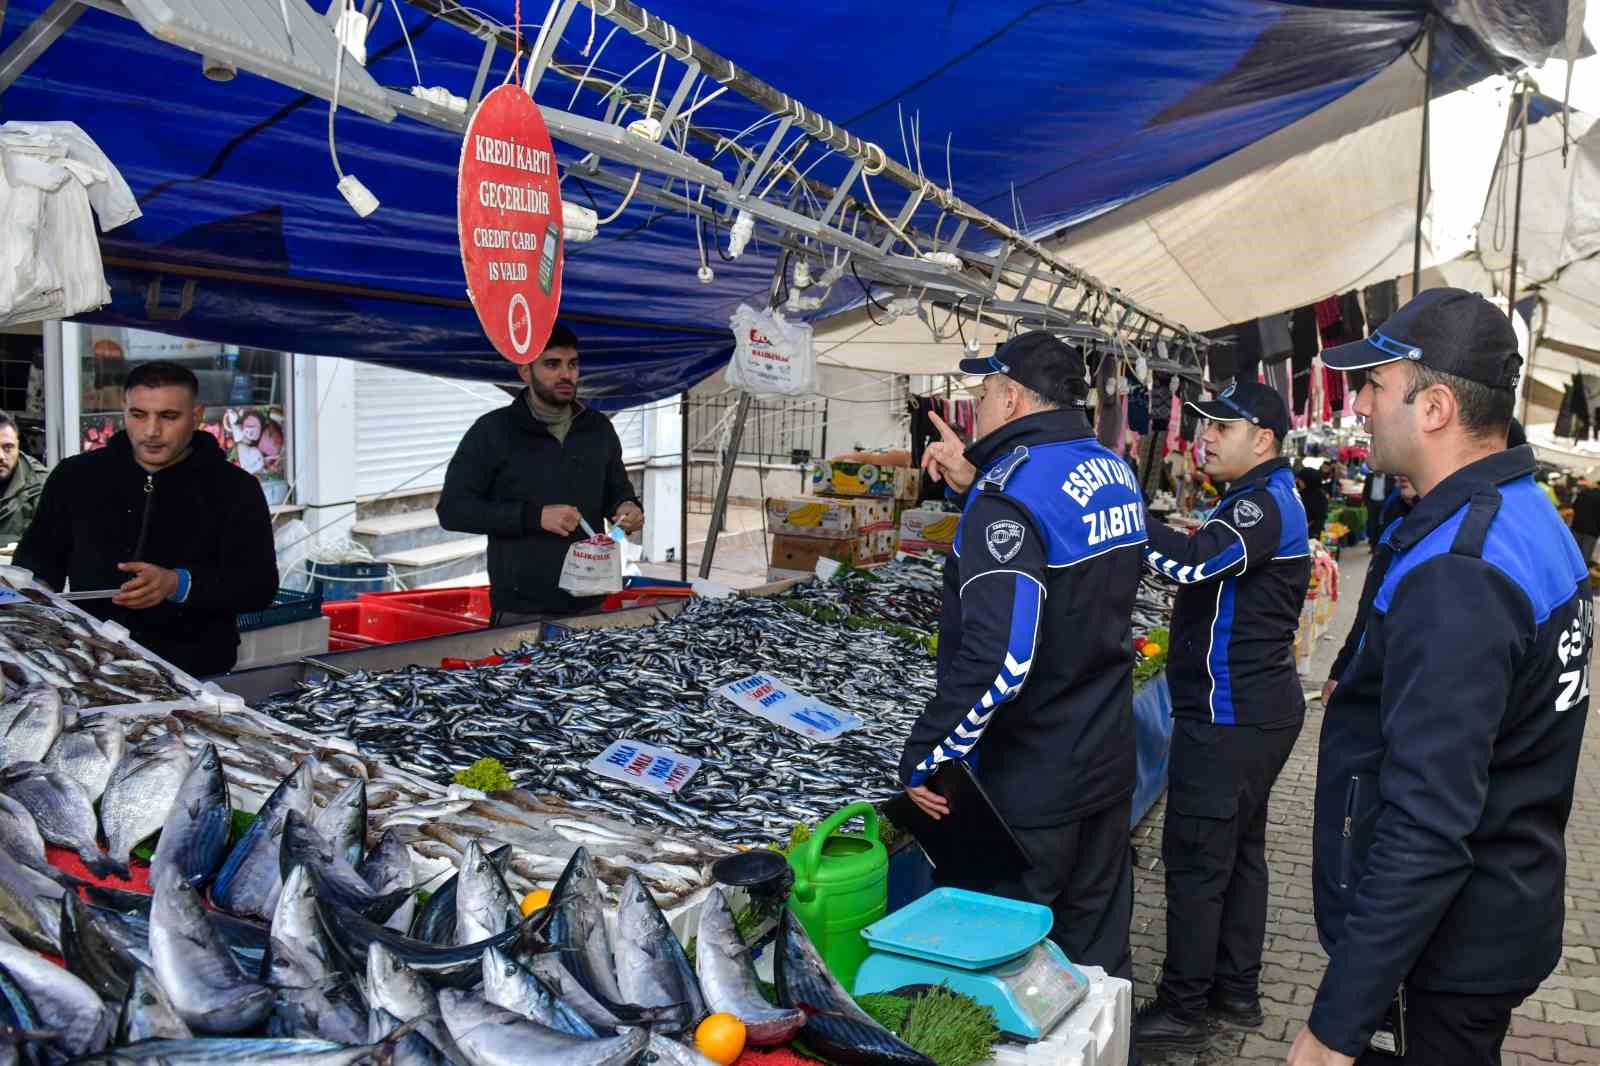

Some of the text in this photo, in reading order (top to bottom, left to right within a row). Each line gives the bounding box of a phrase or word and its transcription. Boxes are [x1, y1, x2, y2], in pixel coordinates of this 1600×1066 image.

[475, 134, 550, 175] KREDİ KARTI
[480, 181, 550, 216] GEÇERLİDİR
[474, 227, 537, 250] CREDIT CARD
[488, 262, 528, 281] IS VALID
